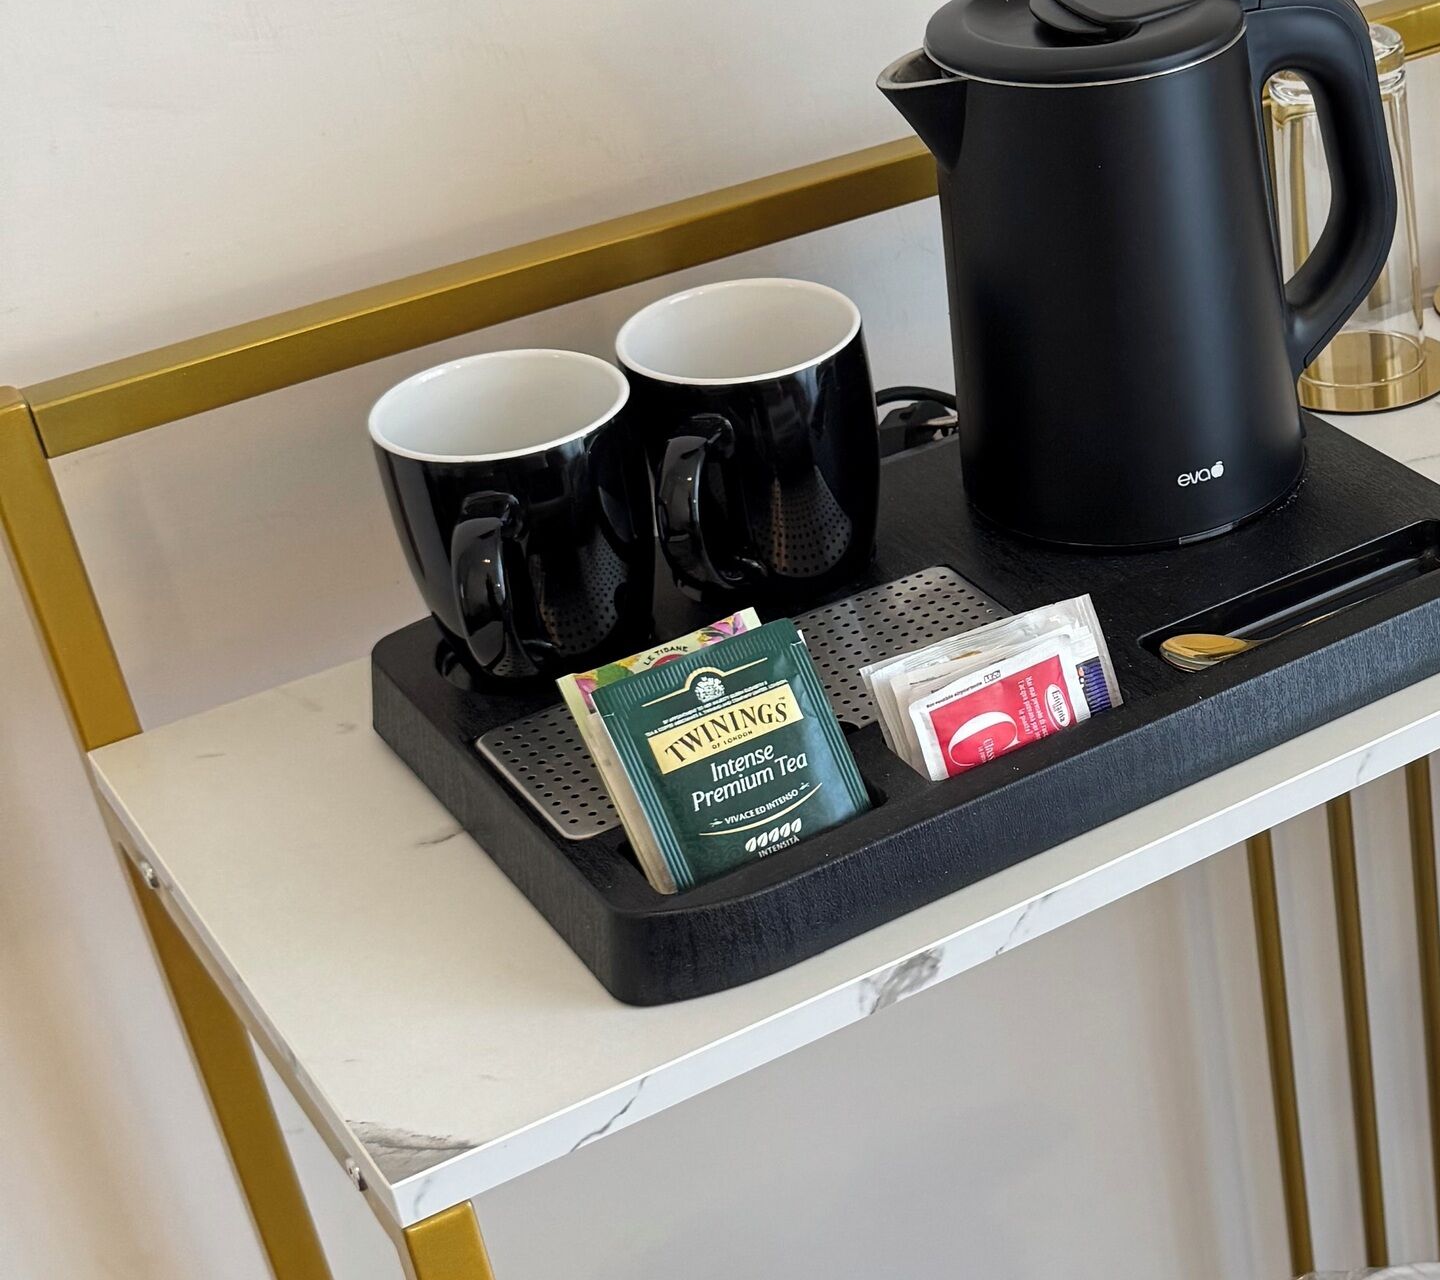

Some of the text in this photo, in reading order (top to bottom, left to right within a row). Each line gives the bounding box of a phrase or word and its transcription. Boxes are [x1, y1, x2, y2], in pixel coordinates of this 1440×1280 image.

[643, 657, 655, 666] LE
[664, 702, 788, 765] TWININGS
[711, 730, 753, 750] OF LONDON
[710, 744, 774, 782] Intense
[691, 752, 808, 812] Premium Tea
[724, 789, 799, 825] VIVACE ED INTENSO
[758, 835, 800, 858] INTENSITÀ
